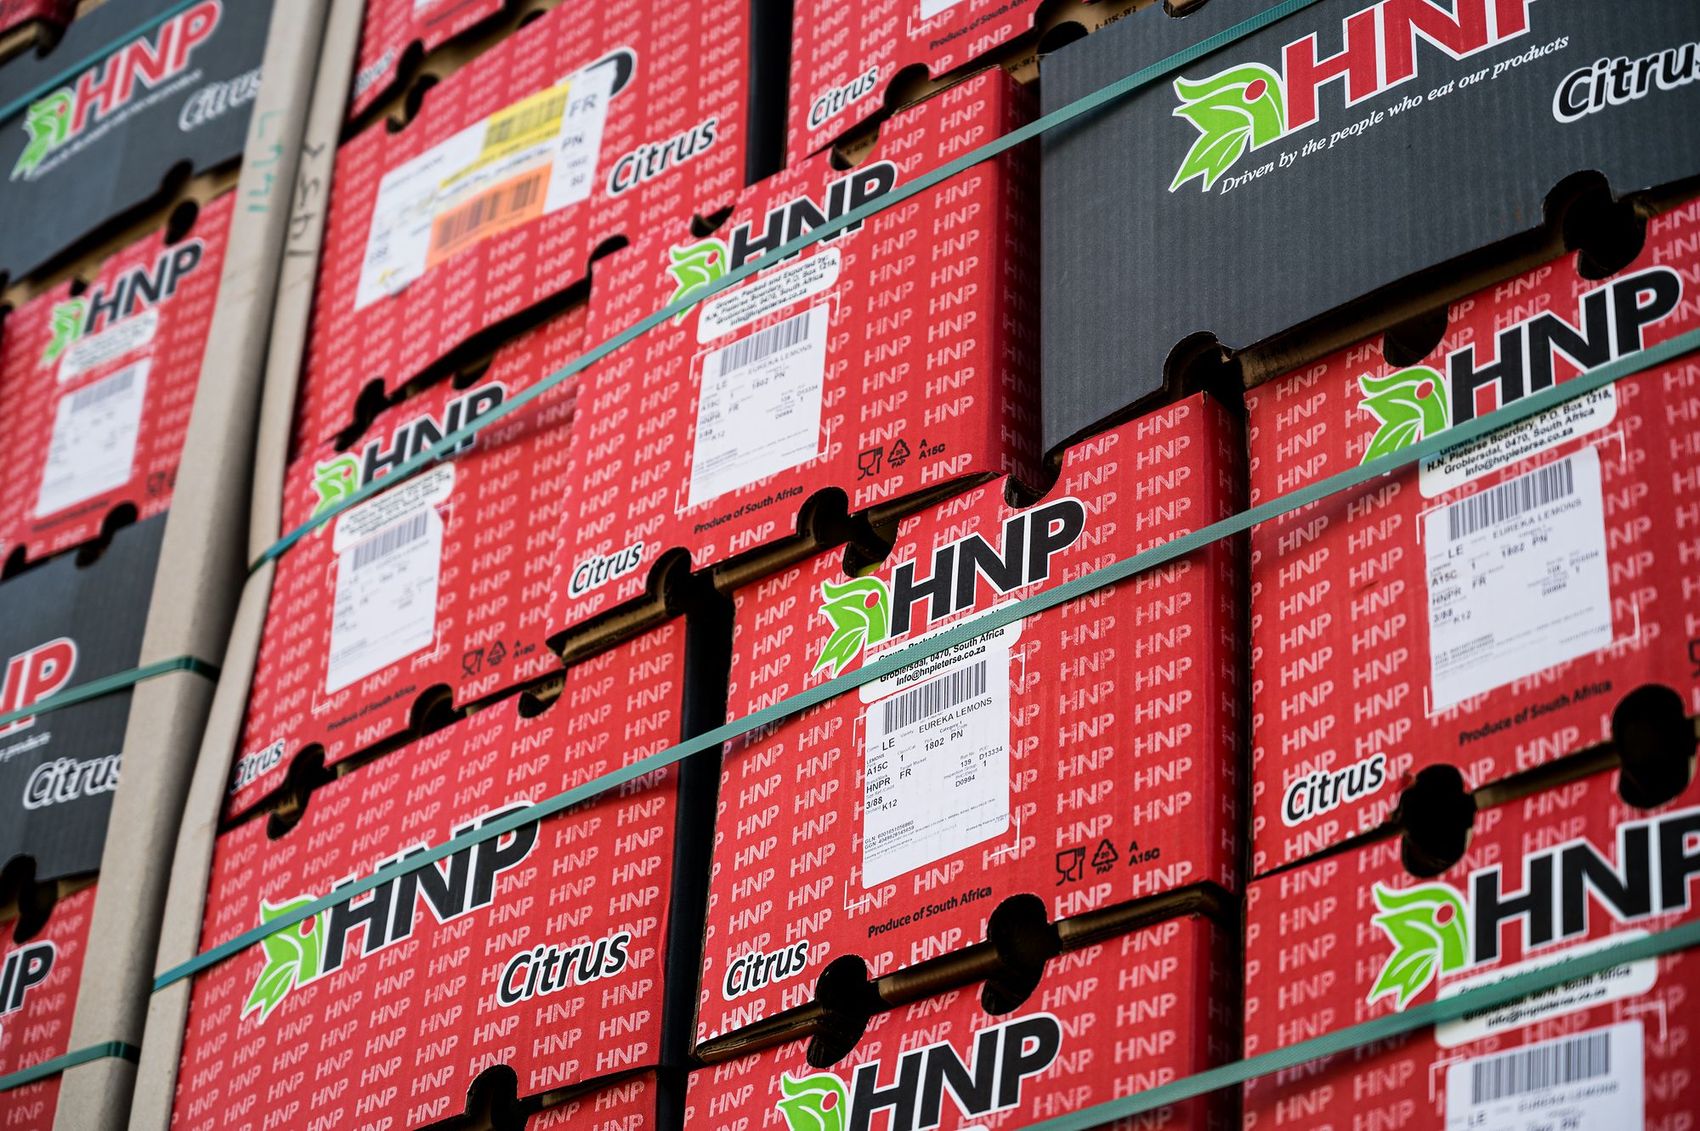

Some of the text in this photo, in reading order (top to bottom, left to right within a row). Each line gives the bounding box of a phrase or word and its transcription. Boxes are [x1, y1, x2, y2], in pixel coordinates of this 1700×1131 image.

[70, 0, 222, 135] HNP
[1552, 42, 1700, 124] Citru
[647, 86, 686, 116] HNP
[806, 66, 879, 131] Citrus
[1220, 35, 1569, 195] Driven by the people who eat our products
[605, 118, 718, 196] Citrus
[695, 145, 737, 175] HNP
[935, 177, 981, 209] HNP
[728, 160, 898, 284] HNP
[932, 229, 979, 261] HNP
[84, 238, 205, 335] HNP
[927, 339, 976, 370] HNP
[1449, 265, 1683, 432] HNP
[1277, 365, 1327, 401] HNP
[360, 381, 507, 488] HNP
[859, 419, 906, 450] HNP
[1449, 439, 1487, 462] Pieterse
[631, 460, 671, 493] HNP
[1136, 466, 1191, 500] HNP
[693, 485, 804, 534] Produce of South Africa
[1348, 484, 1400, 522] HNP
[474, 520, 515, 548] HNP
[1448, 544, 1463, 559] LE
[568, 541, 645, 598] Citrus
[889, 498, 1086, 640] HNP
[464, 621, 506, 651] HNP
[930, 648, 952, 666] 0470,
[953, 636, 978, 654] South
[979, 627, 1005, 643] Africa
[1280, 613, 1331, 653] HNP
[896, 645, 986, 686] info@hnpieterse.co.za
[1060, 648, 1115, 681] HNP
[571, 677, 614, 708] HNP
[1135, 690, 1192, 724] HNP
[1281, 680, 1334, 721] HNP
[882, 697, 993, 751] LE EUREKA LEMONS
[1458, 680, 1613, 746] Produce of South Africa
[866, 761, 889, 777] A15C
[924, 738, 945, 751] 1802
[950, 730, 964, 741] PN
[1355, 717, 1411, 759] HNP
[458, 751, 498, 782] HNP
[866, 745, 1003, 794] HNPR FR 139 D13334
[866, 774, 976, 812] 3/88 K12 D0994
[1057, 780, 1113, 814] HNP
[1282, 752, 1387, 828] Citrus
[615, 826, 663, 856] HNP
[792, 811, 837, 846] HNP
[1128, 847, 1160, 867] A15C
[1129, 840, 1138, 853] A
[914, 860, 964, 895] HNP
[1096, 863, 1114, 875] PAP
[322, 800, 541, 974] HNP
[788, 876, 833, 910] HNP
[729, 900, 772, 935] HNP
[868, 886, 993, 938] Produce of South Africa
[432, 917, 474, 948] HNP
[496, 931, 631, 1007] Citrus
[721, 939, 810, 1001] Citrus
[1119, 957, 1178, 991] HNP
[906, 991, 959, 1022] HNP
[365, 1027, 406, 1057] HNP
[473, 1015, 520, 1046] HNP
[596, 1042, 648, 1072] HNP
[848, 1012, 1062, 1131] HNP
[709, 1084, 754, 1118] HNP
